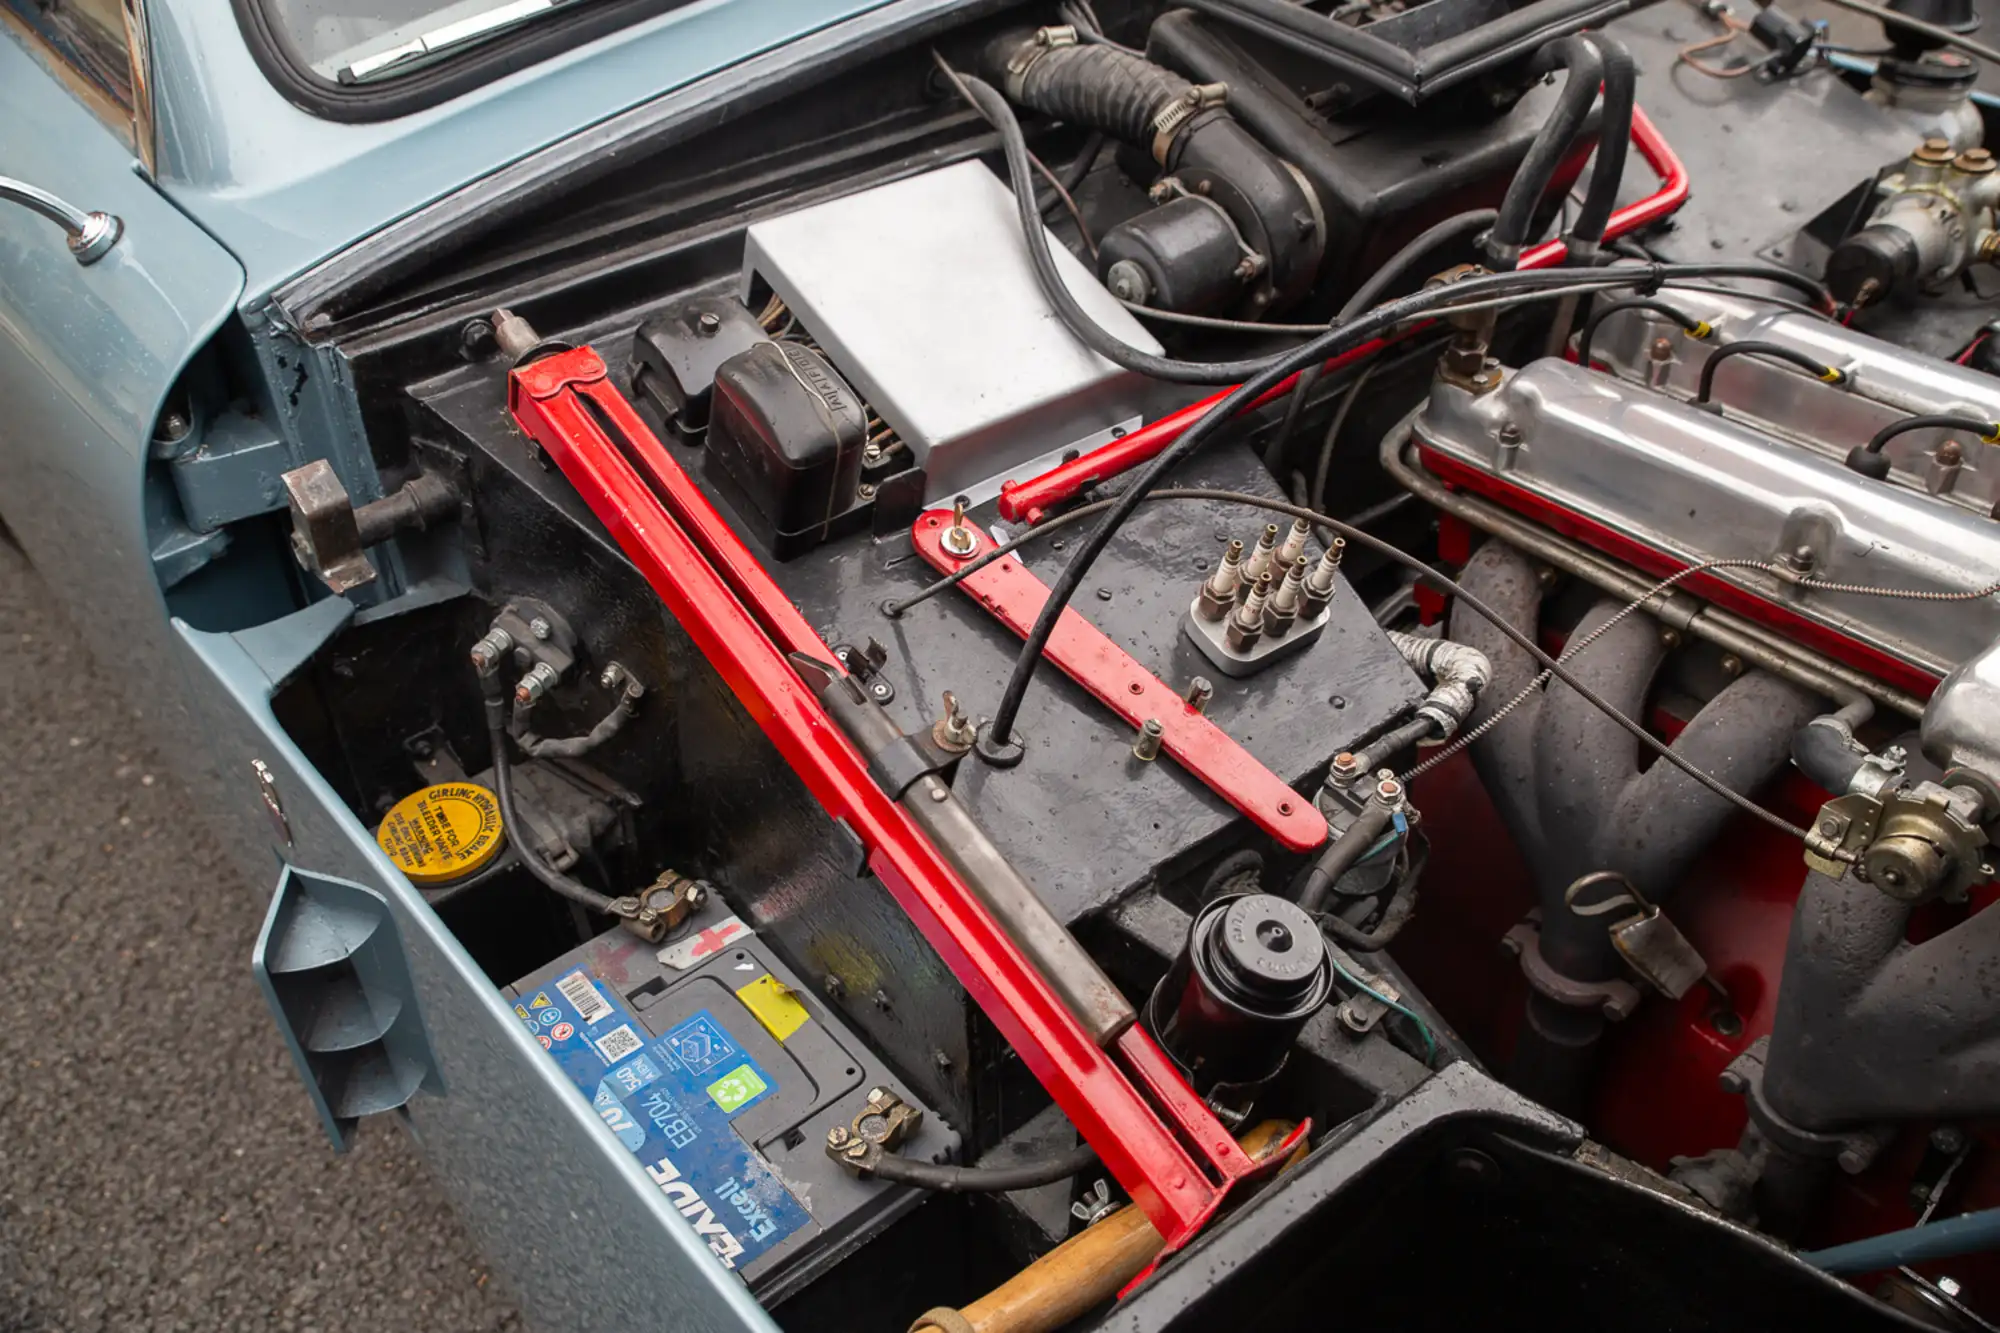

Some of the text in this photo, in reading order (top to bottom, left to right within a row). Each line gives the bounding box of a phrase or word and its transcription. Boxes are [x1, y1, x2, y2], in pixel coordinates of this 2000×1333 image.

[394, 812, 406, 824] USE
[412, 818, 434, 854] WARNING
[418, 800, 453, 860] BLEEDER VALVE
[429, 788, 496, 861] GIRLING HYDRAULIC BRAKE
[446, 829, 460, 847] FOR
[615, 1065, 642, 1092] 540
[641, 1090, 698, 1150] EB704
[644, 1156, 746, 1271] EXIDE
[714, 1175, 778, 1243] Excell
